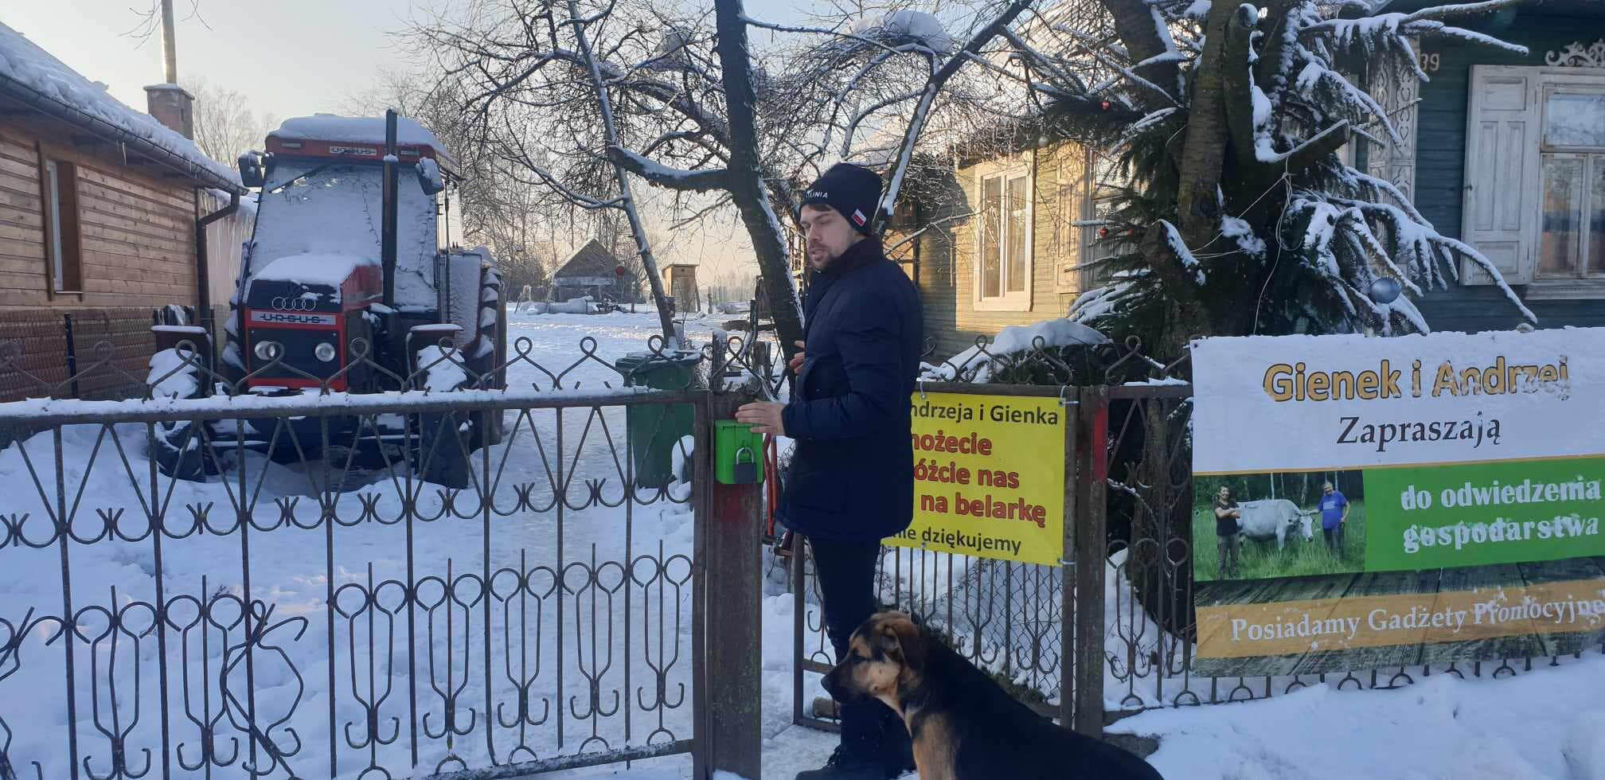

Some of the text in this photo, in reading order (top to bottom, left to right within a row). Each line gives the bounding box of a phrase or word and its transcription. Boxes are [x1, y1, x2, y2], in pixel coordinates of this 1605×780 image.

[262, 313, 324, 324] URSUS
[1263, 354, 1570, 402] Gienek i Andrzej
[911, 401, 1058, 425] ndrzeja i Gienka
[1336, 410, 1501, 452] Zapraszają
[914, 458, 1020, 489] óżcie nas
[920, 492, 1046, 528] na belarkę
[1401, 475, 1602, 511] do odwiedzenia
[921, 526, 1022, 556] dziękujemy
[1403, 514, 1599, 554] gospodarstwa
[1230, 613, 1360, 642] Posiadamy
[1368, 607, 1467, 633] Gadżety
